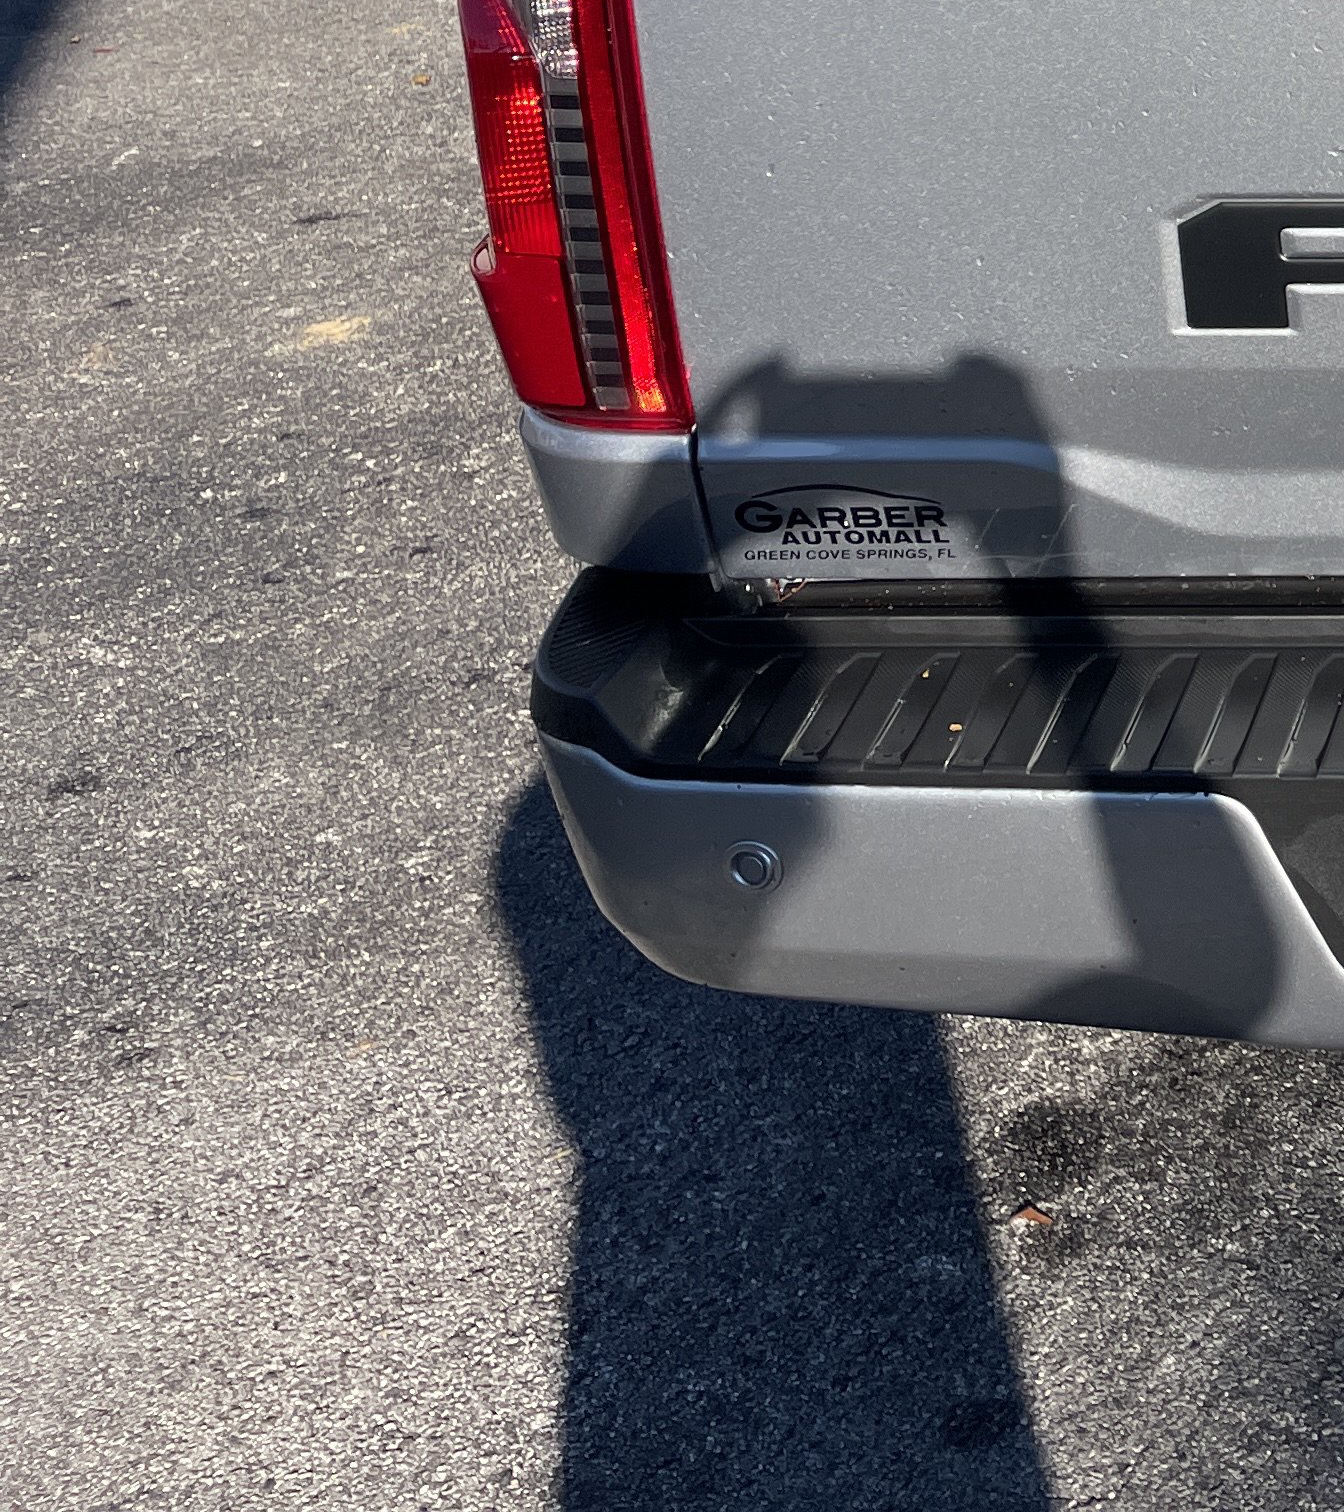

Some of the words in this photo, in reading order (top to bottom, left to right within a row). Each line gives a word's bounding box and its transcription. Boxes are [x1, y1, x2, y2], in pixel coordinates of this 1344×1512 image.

[733, 500, 948, 534] GARBER
[781, 529, 951, 546] AUTOMALL
[744, 548, 801, 562] GREEN
[805, 548, 851, 561] COVE
[855, 547, 933, 562] SPRINGS,
[937, 548, 957, 560] FL
